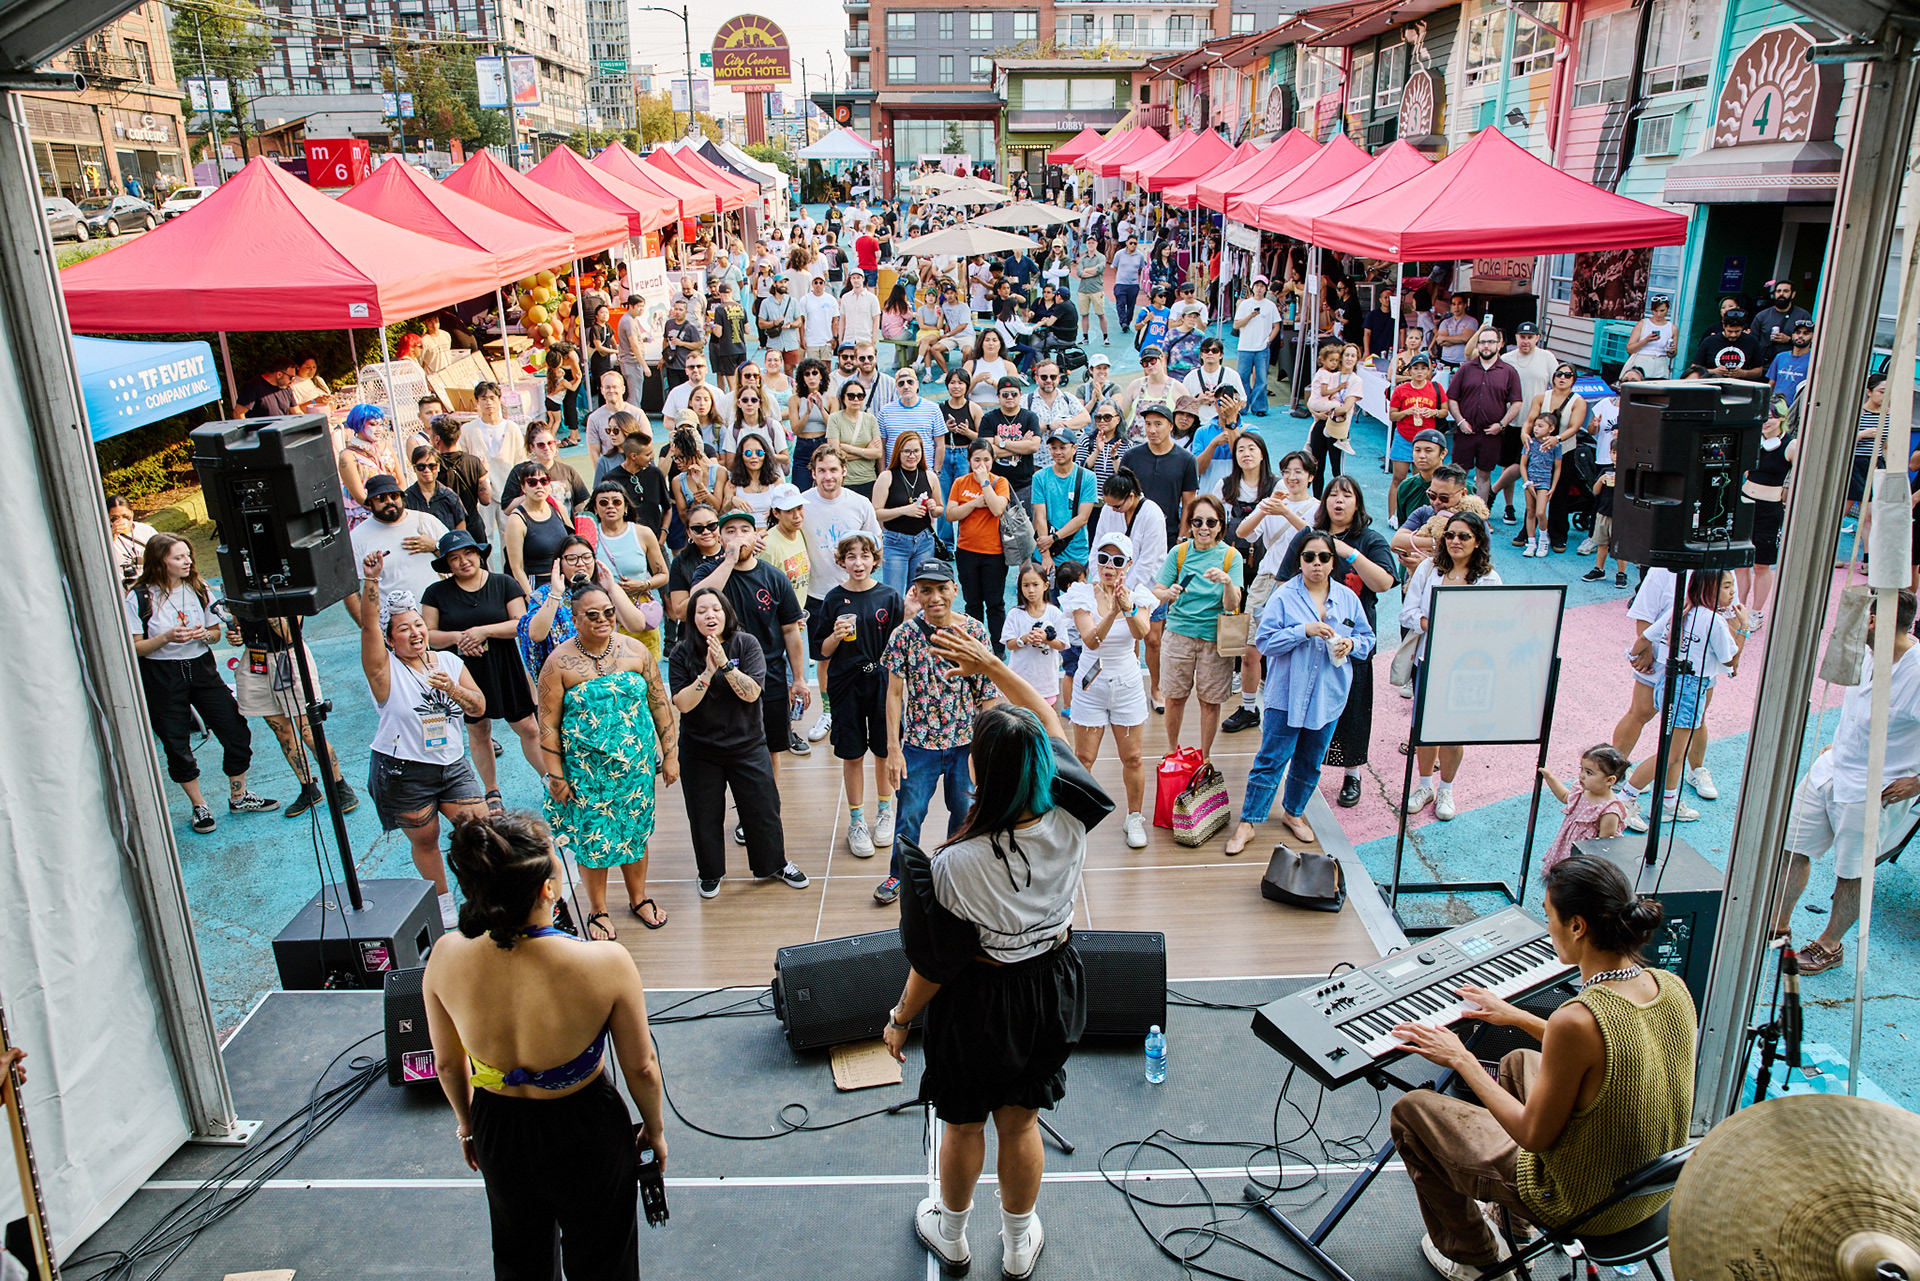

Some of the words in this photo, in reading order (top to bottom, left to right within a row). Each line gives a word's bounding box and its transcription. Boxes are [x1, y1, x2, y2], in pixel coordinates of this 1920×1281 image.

[724, 52, 745, 67] City
[746, 52, 778, 66] Centre
[715, 67, 752, 77] MOTOR
[755, 66, 789, 76] HOTEL
[1411, 107, 1418, 131] 3
[1752, 92, 1772, 135] 4
[1057, 121, 1084, 130] LOBBY
[128, 128, 168, 142] cartems
[311, 146, 329, 160] m
[352, 146, 362, 160] m
[335, 163, 348, 180] 6
[1150, 324, 1165, 336] 04
[137, 368, 158, 391] TF
[158, 355, 204, 385] EVENT
[145, 383, 191, 409] COMPANY
[191, 379, 211, 395] INC.
